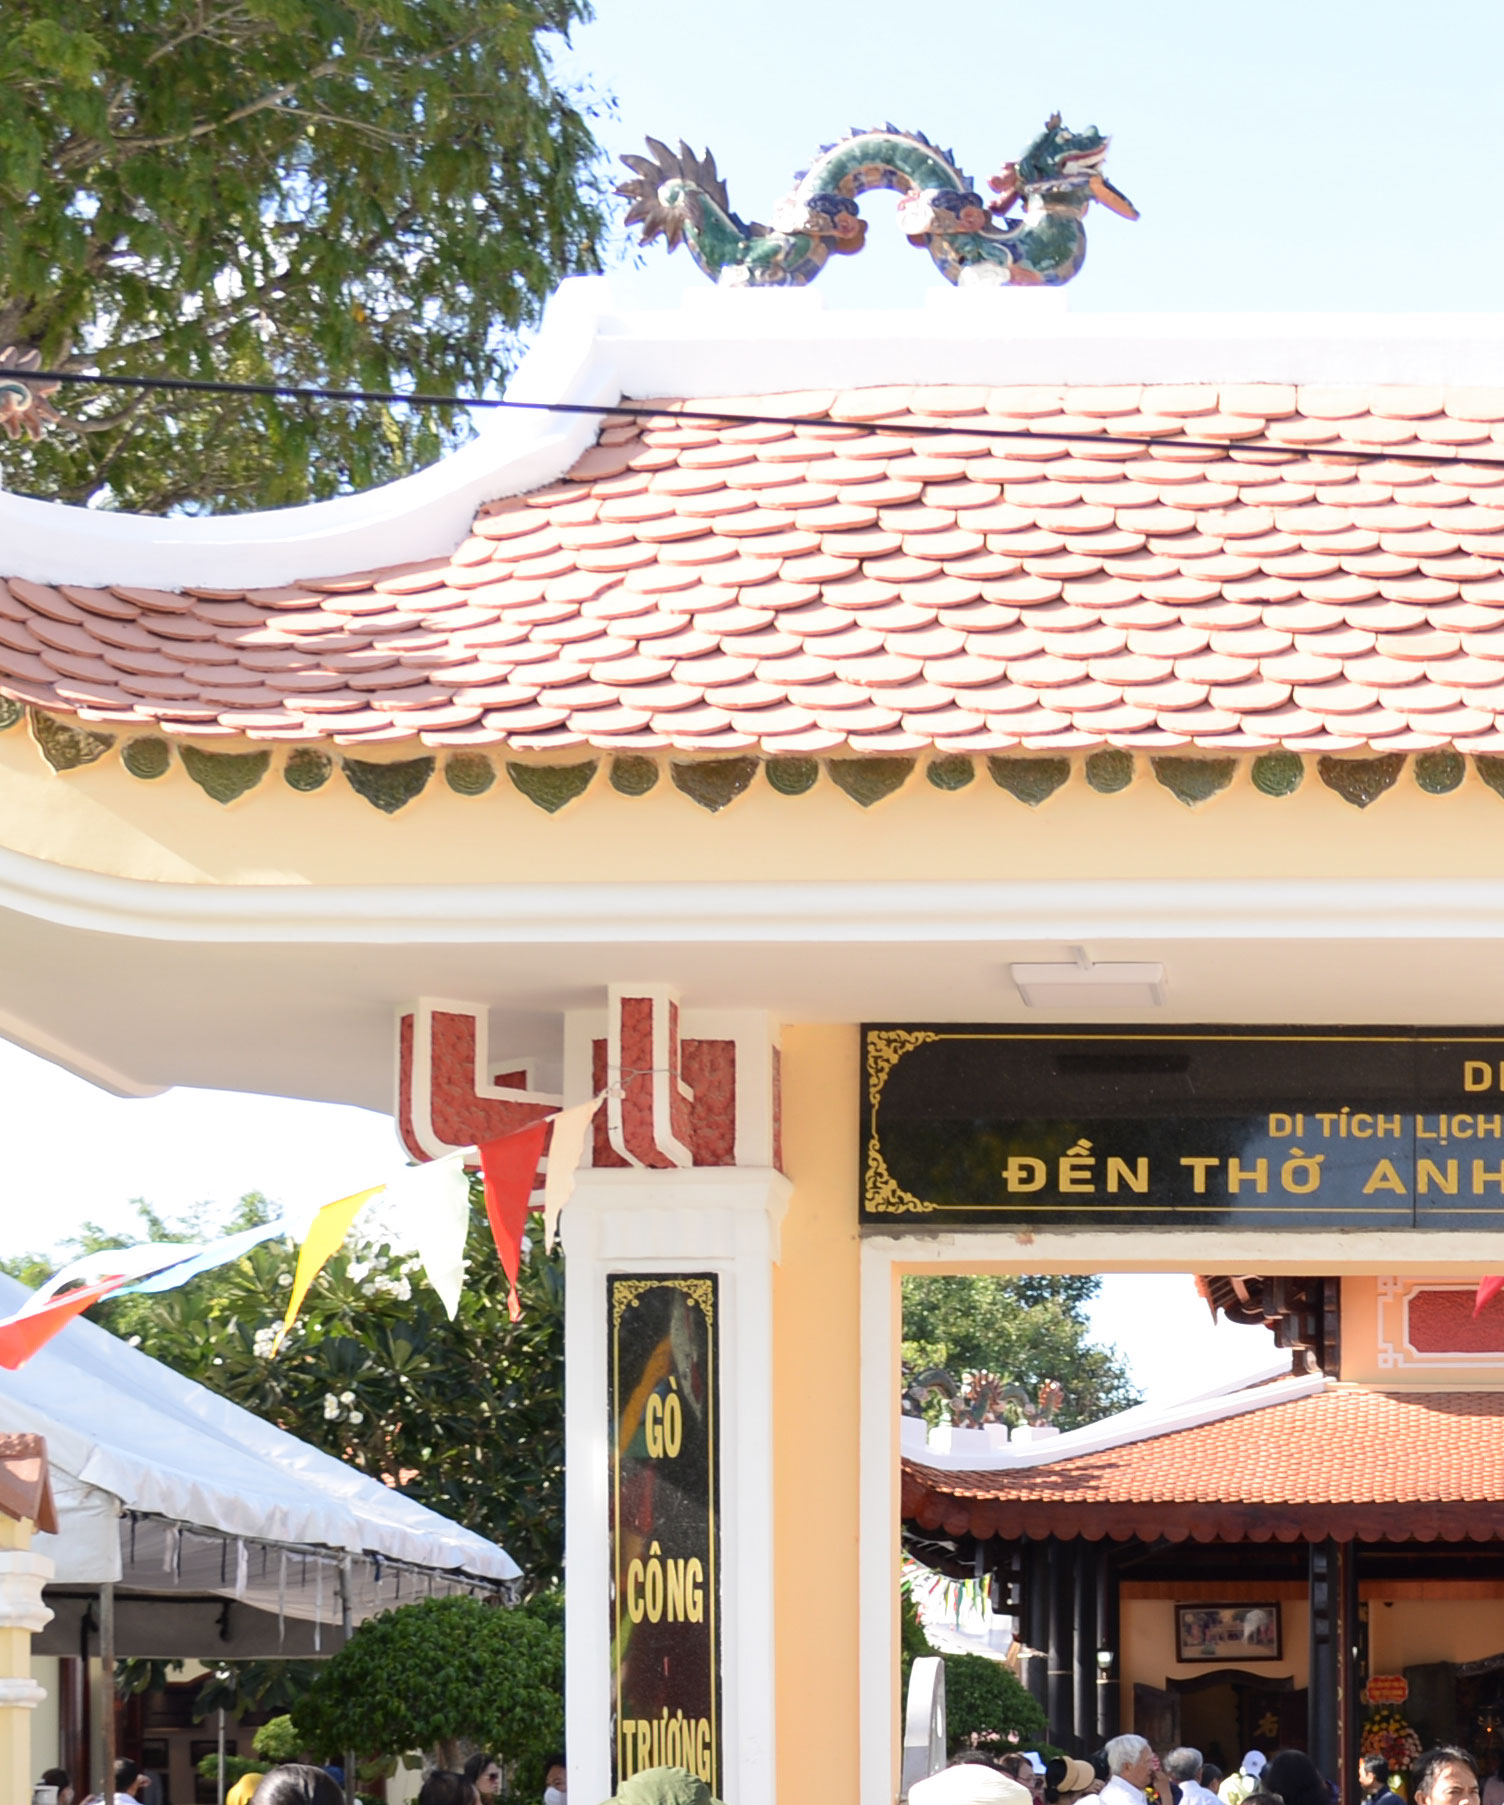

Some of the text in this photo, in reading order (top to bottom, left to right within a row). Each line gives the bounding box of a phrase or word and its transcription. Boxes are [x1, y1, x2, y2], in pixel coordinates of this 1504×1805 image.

[1269, 1114, 1304, 1138] DI
[1316, 1107, 1401, 1138] TÍCH
[1416, 1114, 1501, 1146] LỊCH
[1002, 1139, 1148, 1193] ĐỀN
[1180, 1147, 1324, 1194] THỜ
[645, 1376, 682, 1459] GÒ
[627, 1541, 703, 1623] CÔNG
[622, 1706, 710, 1782] TRƯƠNG
